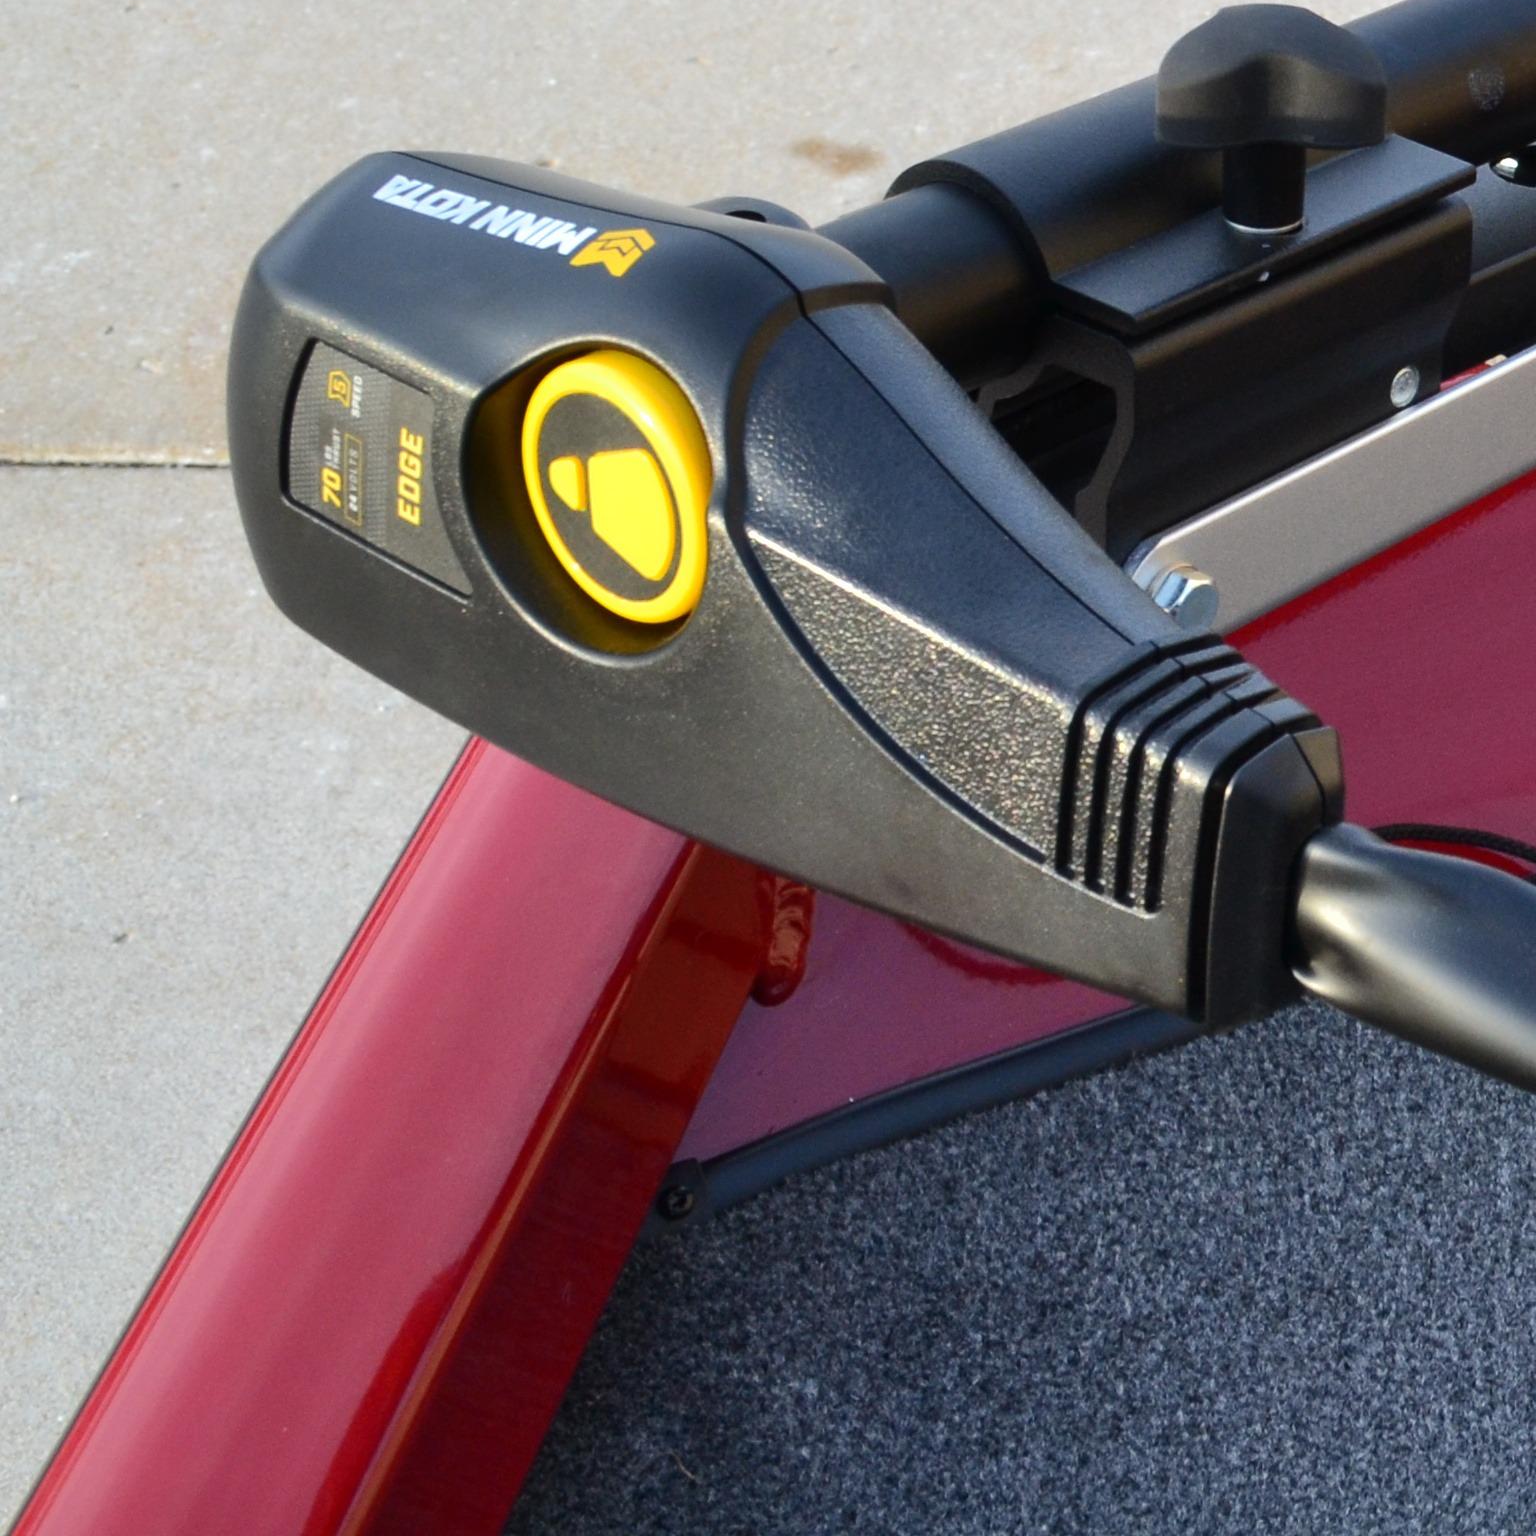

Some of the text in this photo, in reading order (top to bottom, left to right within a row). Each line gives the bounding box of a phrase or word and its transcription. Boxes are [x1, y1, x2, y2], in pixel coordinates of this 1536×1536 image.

[372, 173, 598, 256] MINN KOTA
[352, 375, 363, 418] SPEED
[322, 467, 342, 508] 70
[349, 448, 358, 493] VOLTS
[398, 427, 424, 526] EDGE
